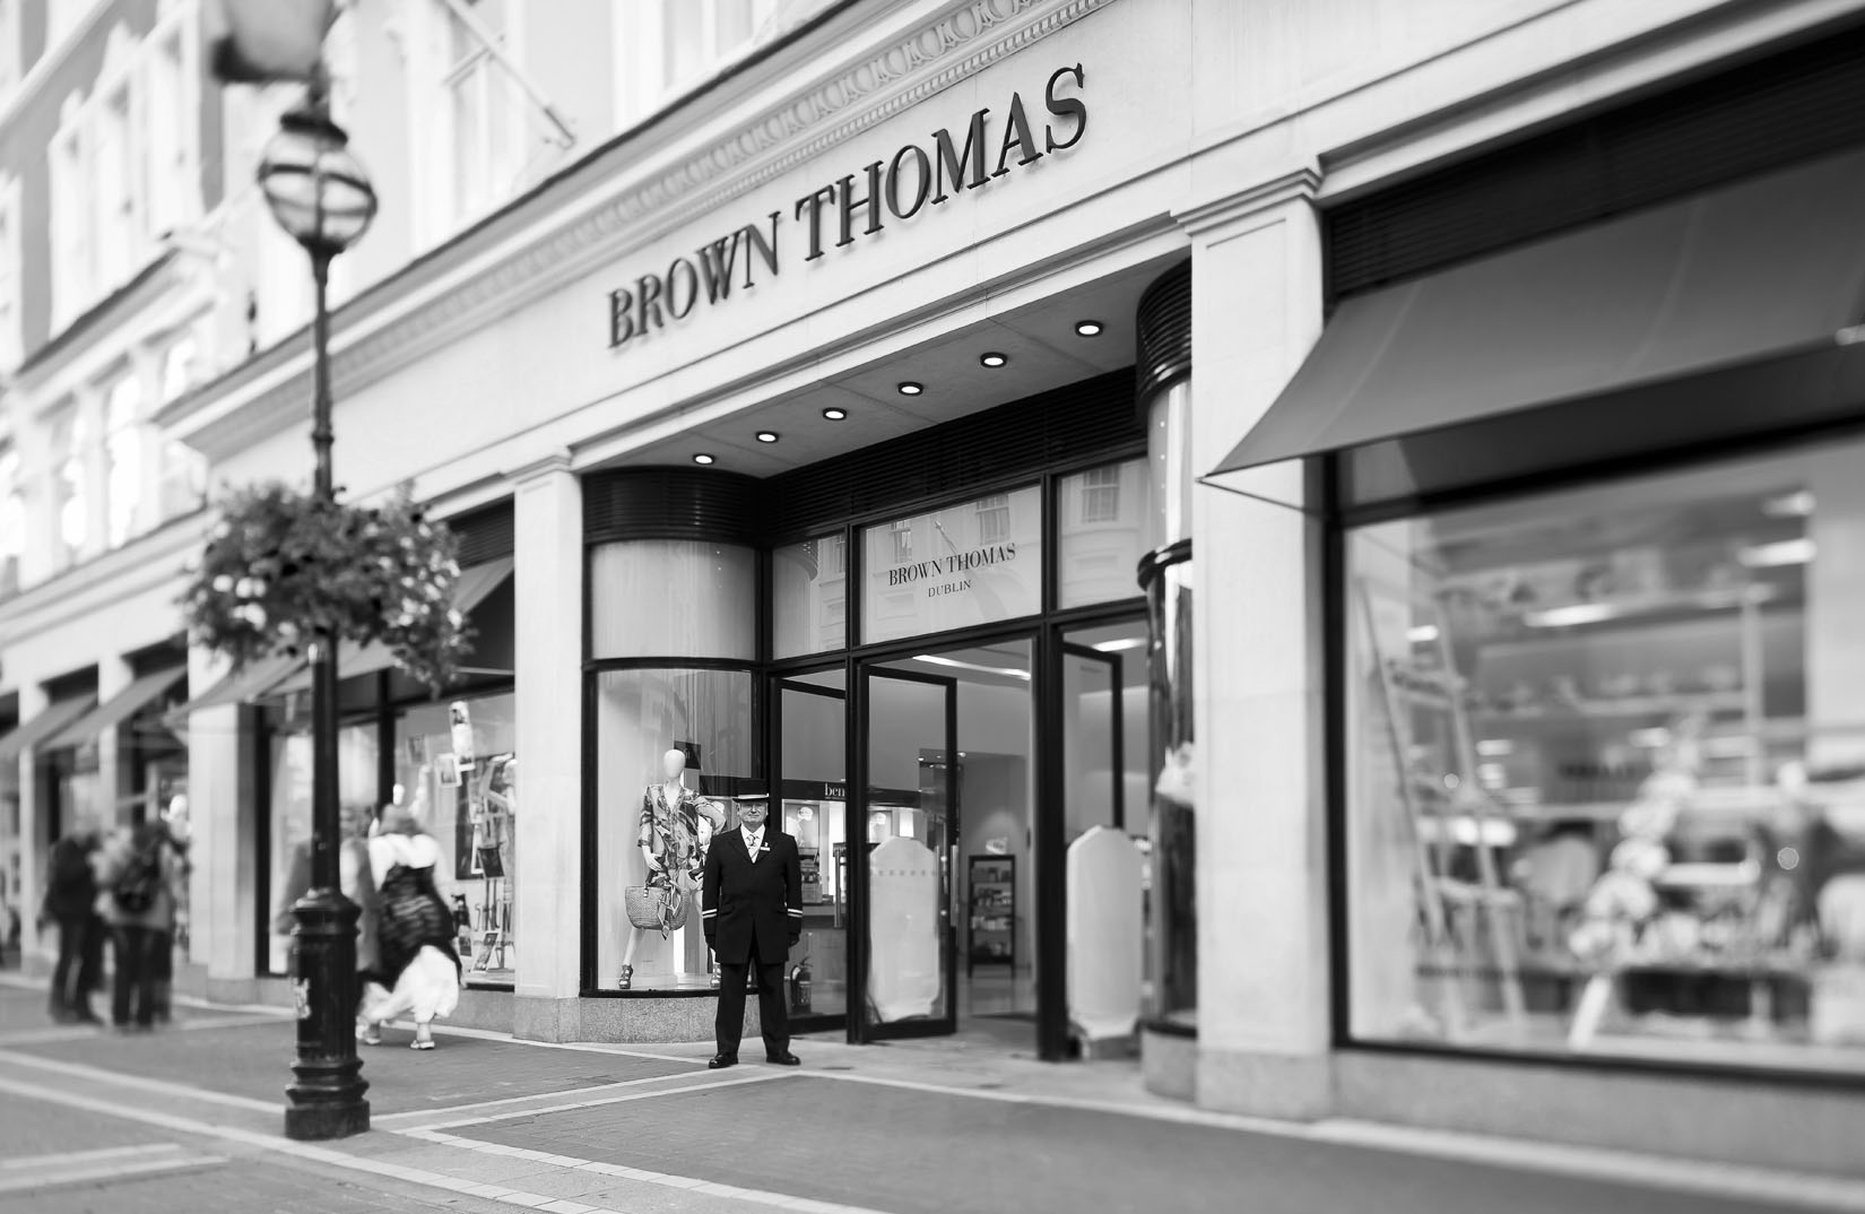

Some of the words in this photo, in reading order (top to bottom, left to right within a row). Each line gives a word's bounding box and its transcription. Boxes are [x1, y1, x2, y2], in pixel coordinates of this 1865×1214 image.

[608, 211, 781, 348] BROWN
[795, 62, 1087, 262] THOMAS
[889, 558, 942, 586] BROWN
[946, 543, 1016, 573] THOMAS
[928, 580, 972, 598] DUBLIN
